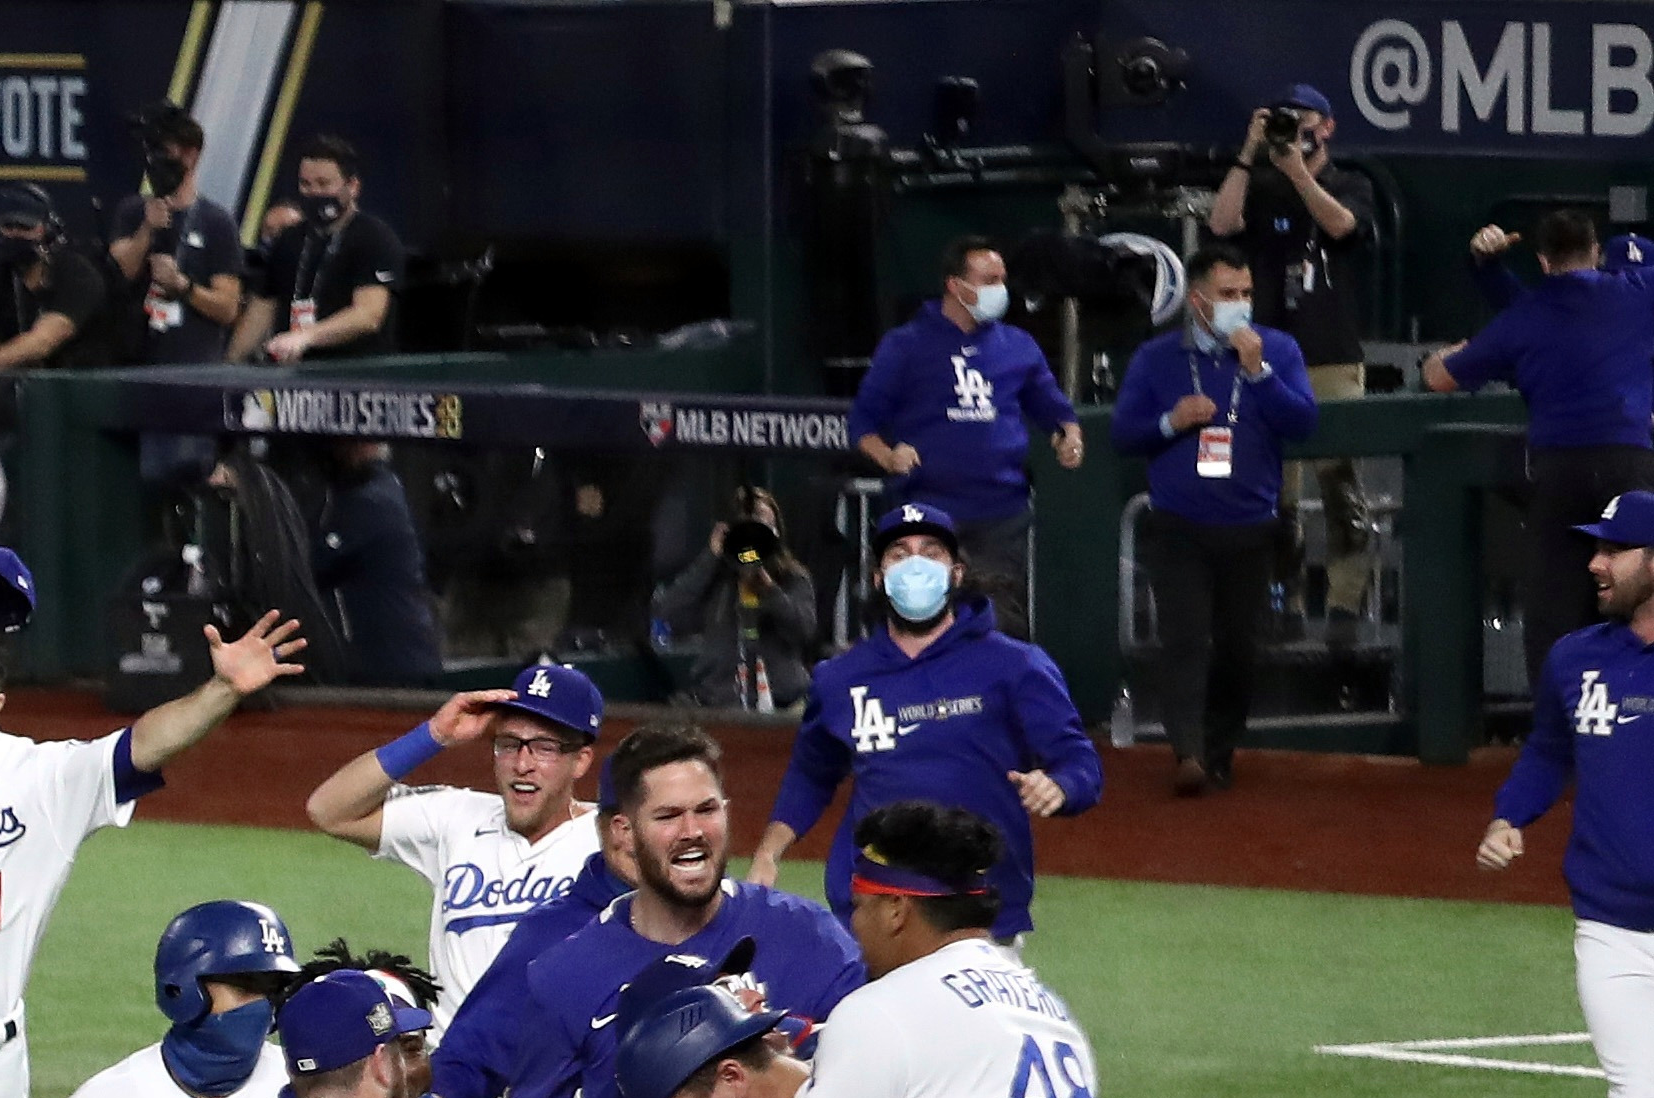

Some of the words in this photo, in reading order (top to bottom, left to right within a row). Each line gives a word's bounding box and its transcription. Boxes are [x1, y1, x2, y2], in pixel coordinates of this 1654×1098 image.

[1350, 18, 1654, 136] @MLB
[950, 354, 994, 409] LA
[273, 388, 356, 434] WORLD
[357, 391, 436, 438] SERIES
[675, 408, 728, 445] MLB
[527, 669, 552, 698] LA
[1574, 669, 1617, 735] LA
[849, 685, 896, 752] LA
[442, 862, 579, 910] Dodge
[257, 918, 285, 954] LA
